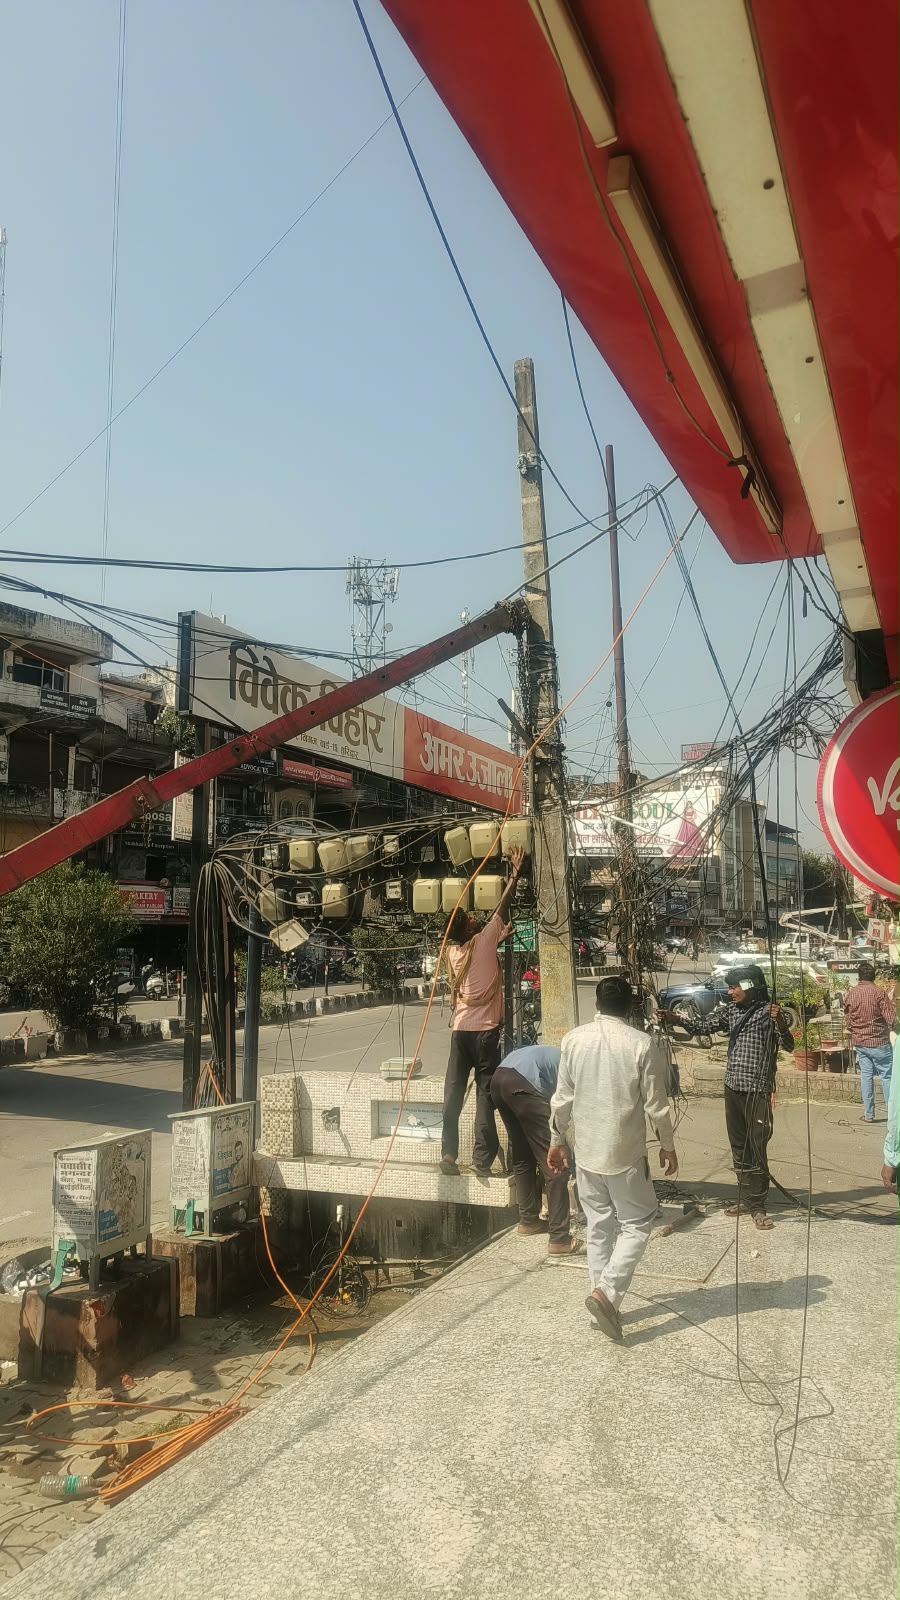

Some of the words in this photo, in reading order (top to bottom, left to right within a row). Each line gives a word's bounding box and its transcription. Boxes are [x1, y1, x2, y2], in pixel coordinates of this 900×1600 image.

[228, 641, 311, 716] विवेक
[420, 732, 466, 783] अमर
[466, 750, 514, 799] उजाला
